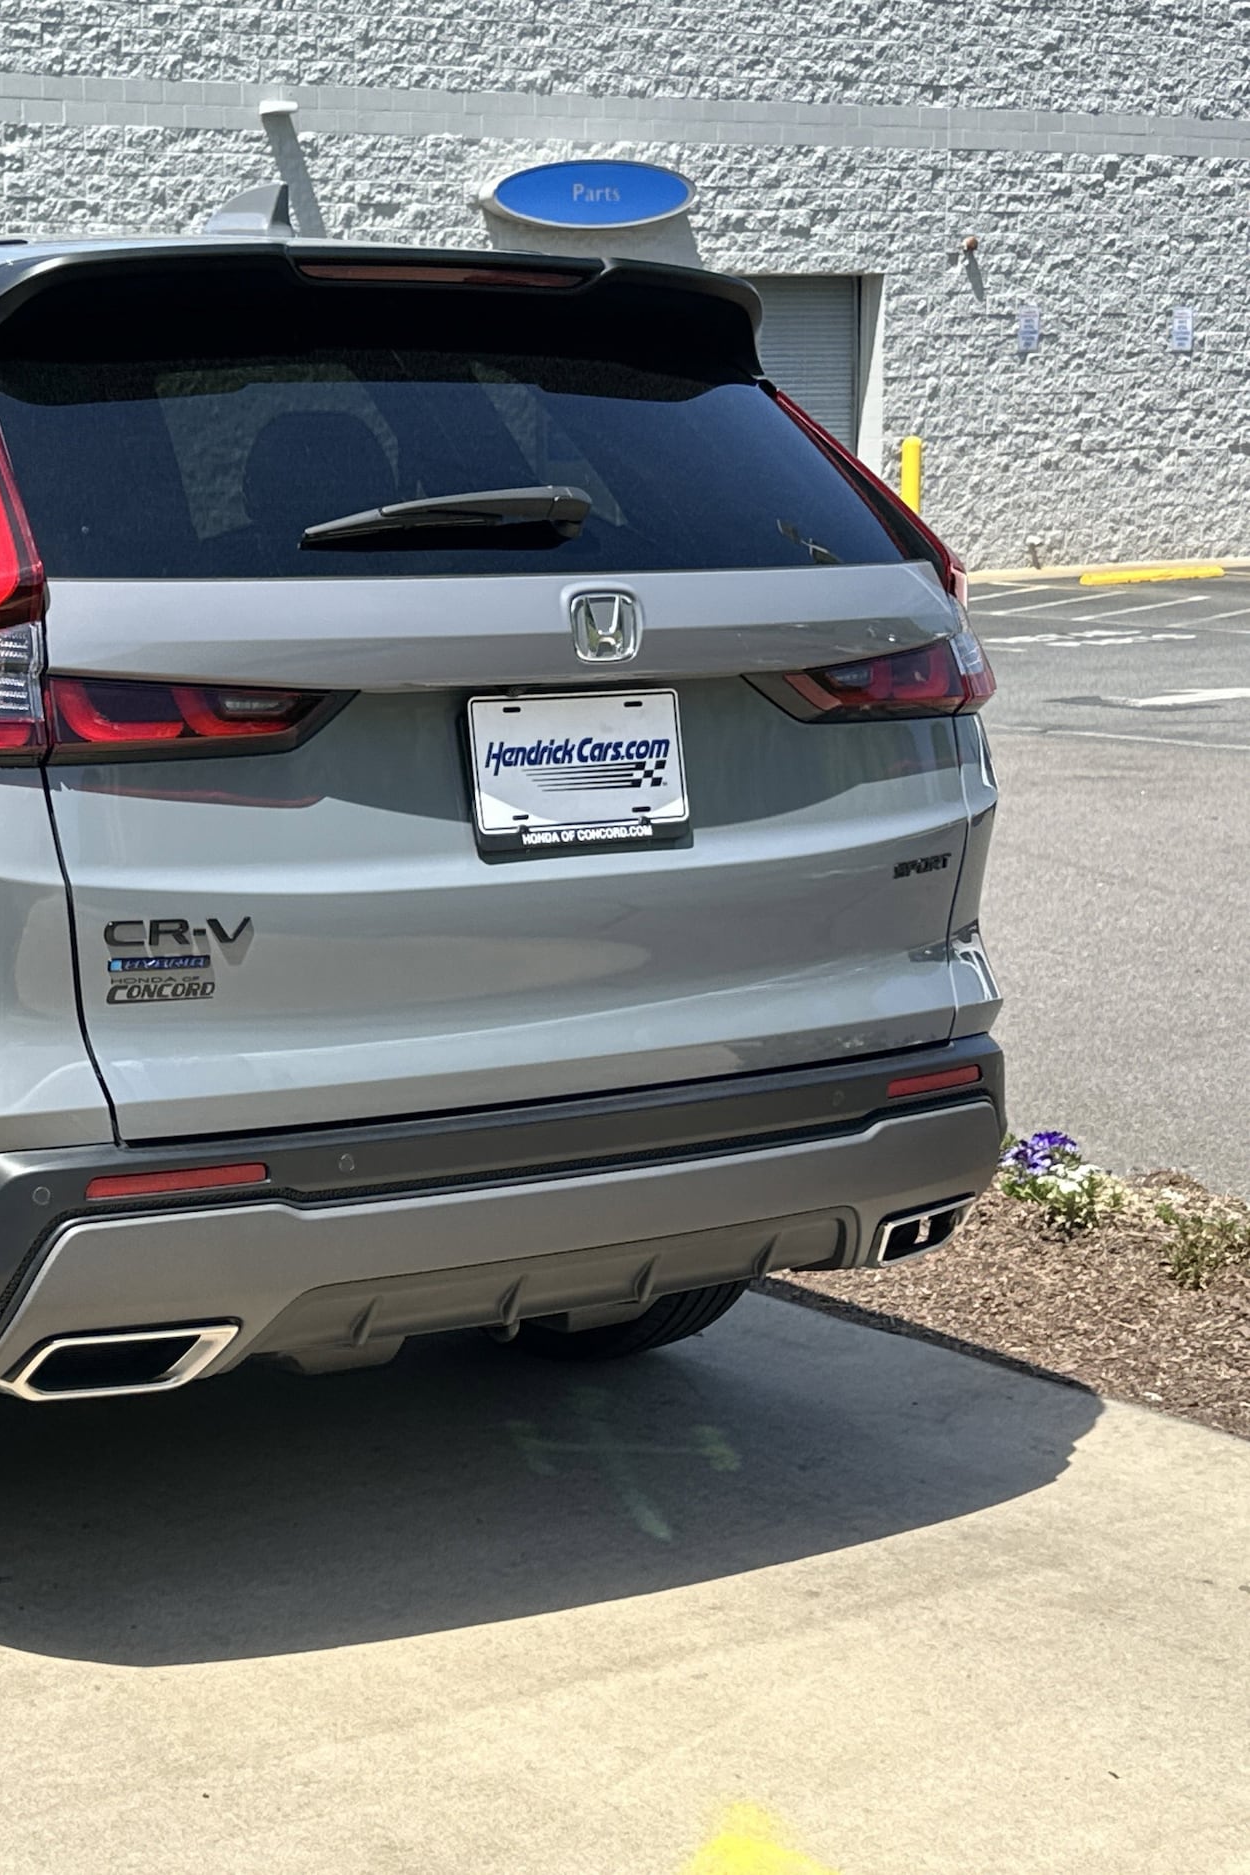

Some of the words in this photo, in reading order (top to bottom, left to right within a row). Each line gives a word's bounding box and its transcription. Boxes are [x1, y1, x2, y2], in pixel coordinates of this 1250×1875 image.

[572, 183, 621, 203] Parts
[522, 832, 559, 846] HONDA
[560, 829, 576, 842] OF
[577, 825, 653, 841] CONCORD.COM
[893, 853, 952, 879] SPORT
[103, 916, 251, 946] CR-V
[110, 976, 177, 985] HONDA
[182, 975, 200, 983] OF
[106, 981, 216, 1005] CONCORD
